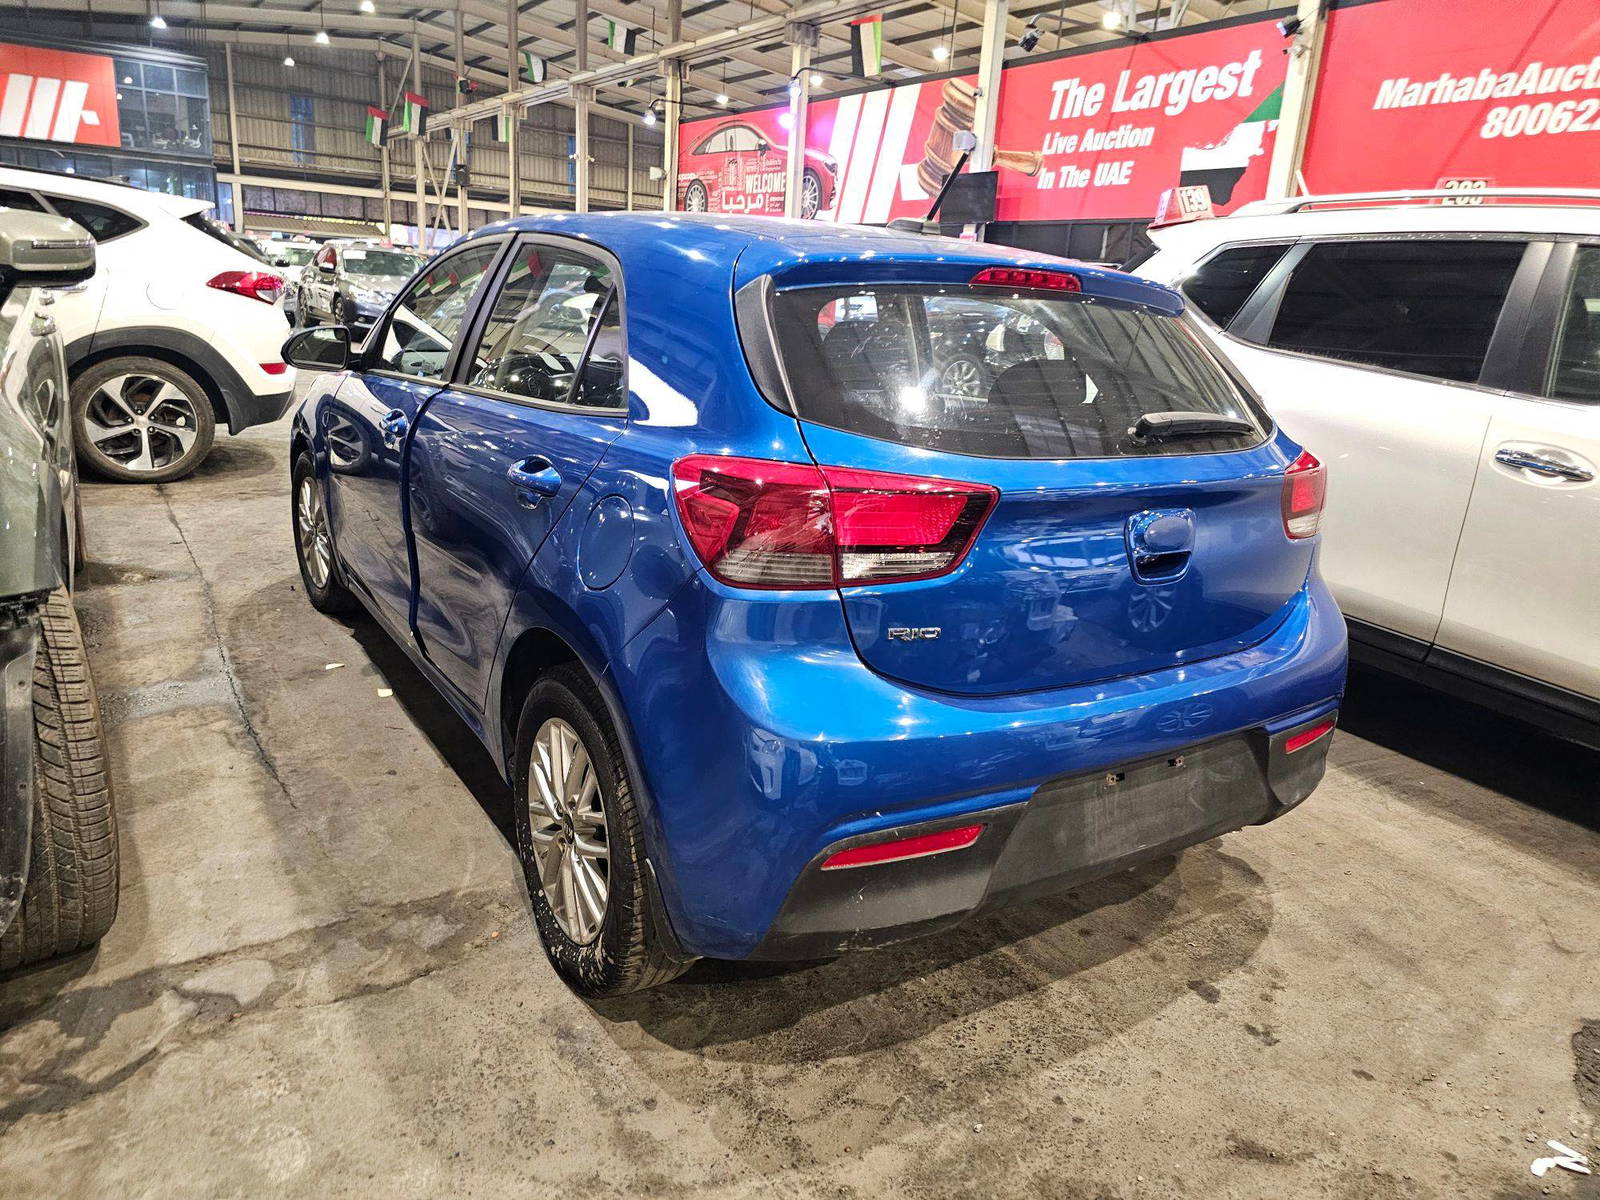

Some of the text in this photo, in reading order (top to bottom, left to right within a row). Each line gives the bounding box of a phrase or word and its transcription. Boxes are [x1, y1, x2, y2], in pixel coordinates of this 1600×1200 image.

[1049, 50, 1263, 121] The Largest
[1372, 56, 1600, 110] MarhabaAuct
[1480, 98, 1600, 139] 80062
[1043, 124, 1155, 155] Live Auction
[745, 172, 786, 194] WELCOME
[1037, 161, 1133, 190] In The UAE
[721, 192, 764, 214] مرحبا
[1180, 188, 1208, 213] 139
[887, 626, 942, 641] RIO
